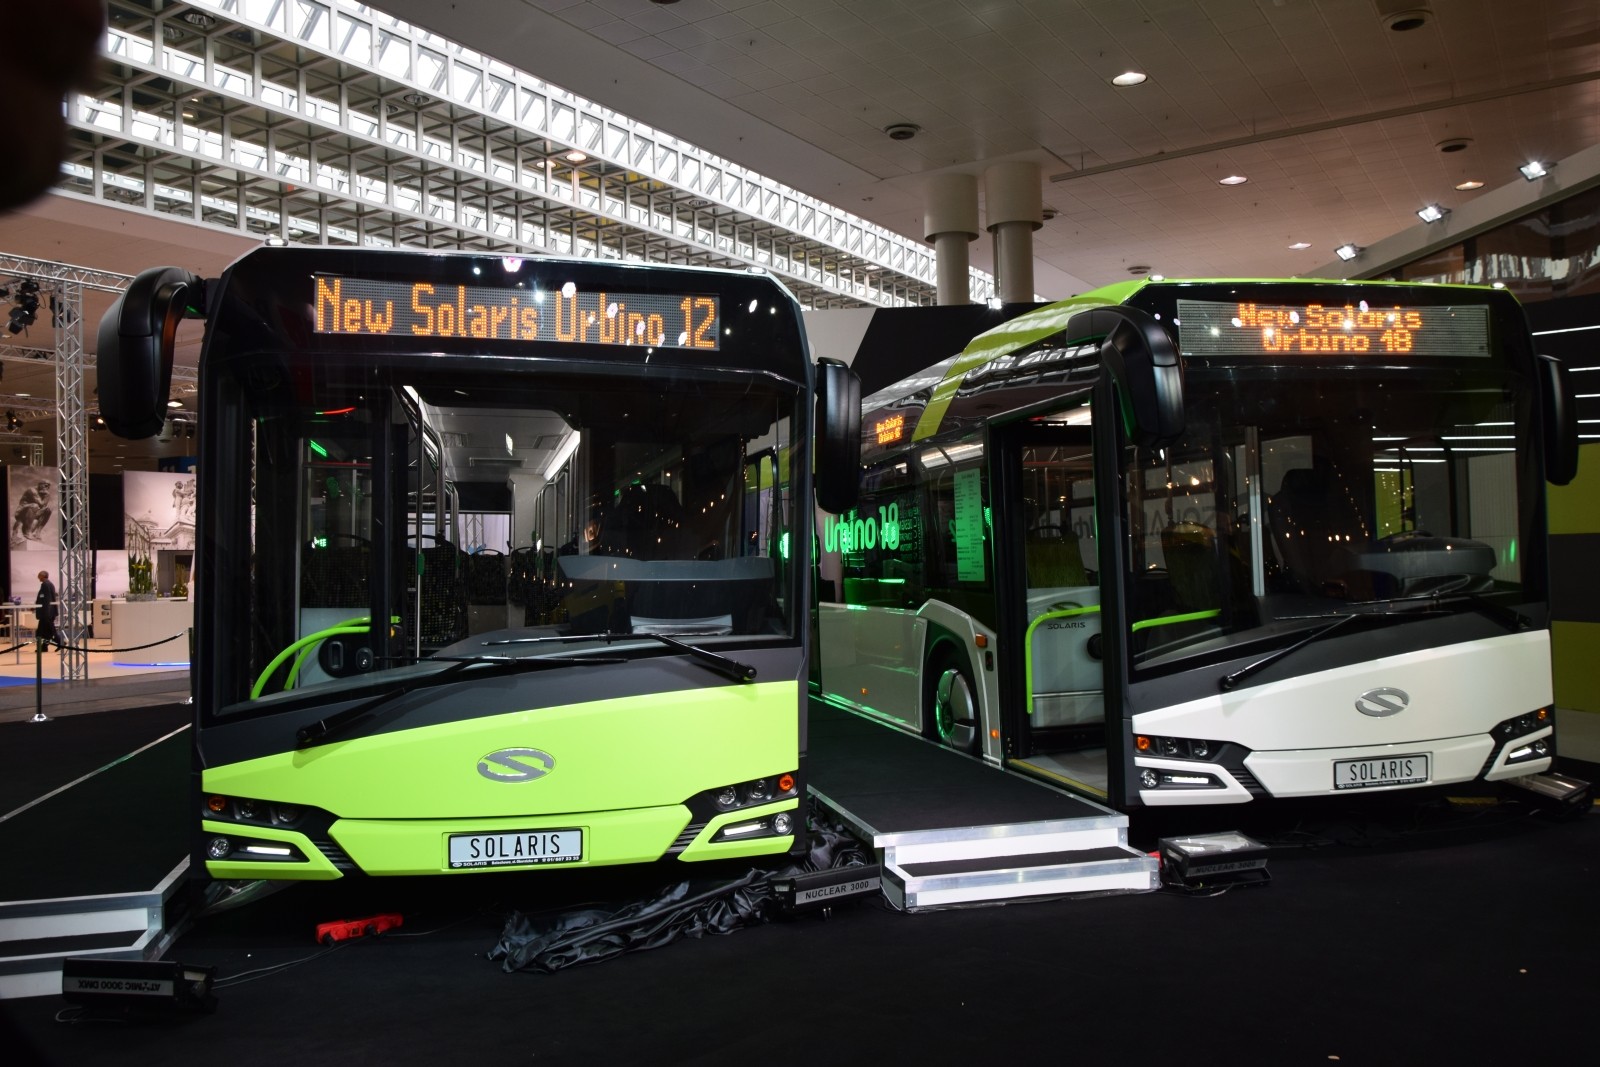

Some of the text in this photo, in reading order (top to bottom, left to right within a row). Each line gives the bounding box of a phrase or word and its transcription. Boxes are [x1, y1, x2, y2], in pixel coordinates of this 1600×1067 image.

[316, 277, 716, 348] New Solaris Urbino 12
[1237, 303, 1422, 329] New Solaris
[1380, 329, 1412, 352] 18
[879, 502, 900, 550] 18
[1047, 621, 1086, 630] SOLARIS
[1349, 759, 1413, 781] SOLARIS
[470, 834, 560, 859] SOLARIS
[1196, 862, 1235, 873] NUCLEAR
[805, 880, 869, 900] NUCLEAR 3000
[78, 979, 99, 990] DMX
[100, 979, 124, 990] 3000
